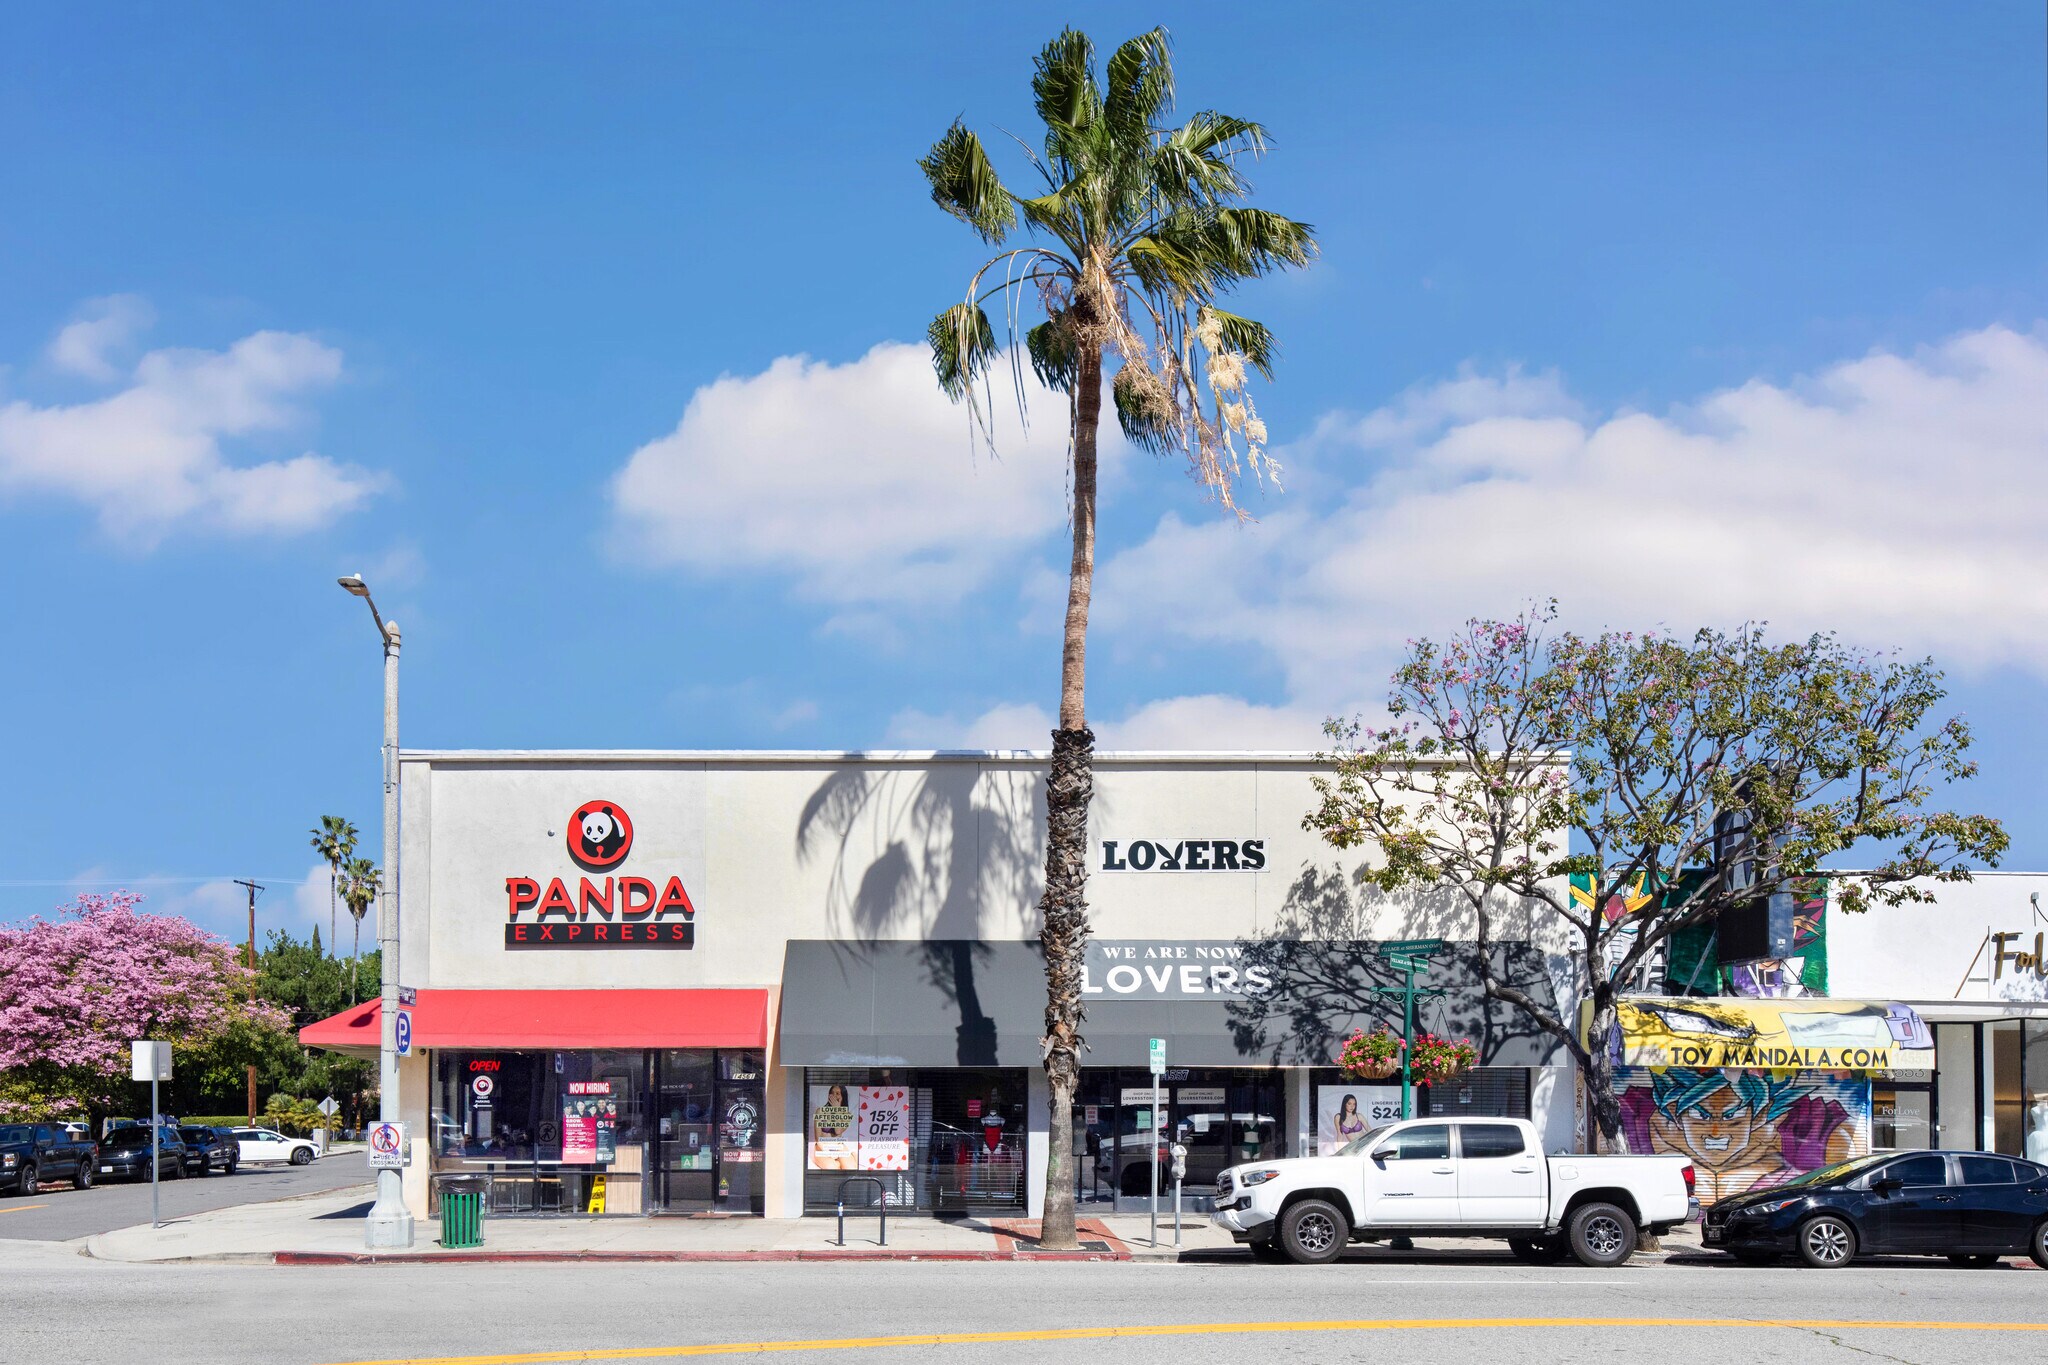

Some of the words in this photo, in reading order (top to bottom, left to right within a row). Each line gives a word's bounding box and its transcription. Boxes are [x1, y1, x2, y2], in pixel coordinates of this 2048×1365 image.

[505, 875, 695, 917] PANDA
[514, 924, 685, 941] EXPRESS
[1102, 946, 1136, 959] WE
[1143, 946, 1188, 959] ARE
[1195, 946, 1244, 959] NOW
[1081, 964, 1272, 993] LOVERS
[399, 1018, 407, 1046] P
[1670, 1047, 1713, 1066] TOY
[1721, 1048, 1889, 1067] MANDALA.COM
[469, 1060, 501, 1071] OPEN
[569, 1082, 585, 1094] NOW
[587, 1082, 609, 1094] HIRING
[869, 1110, 899, 1122] 15%
[1882, 1107, 1920, 1115] ForLove
[869, 1124, 899, 1135] OFF
[683, 1158, 691, 1166] A
